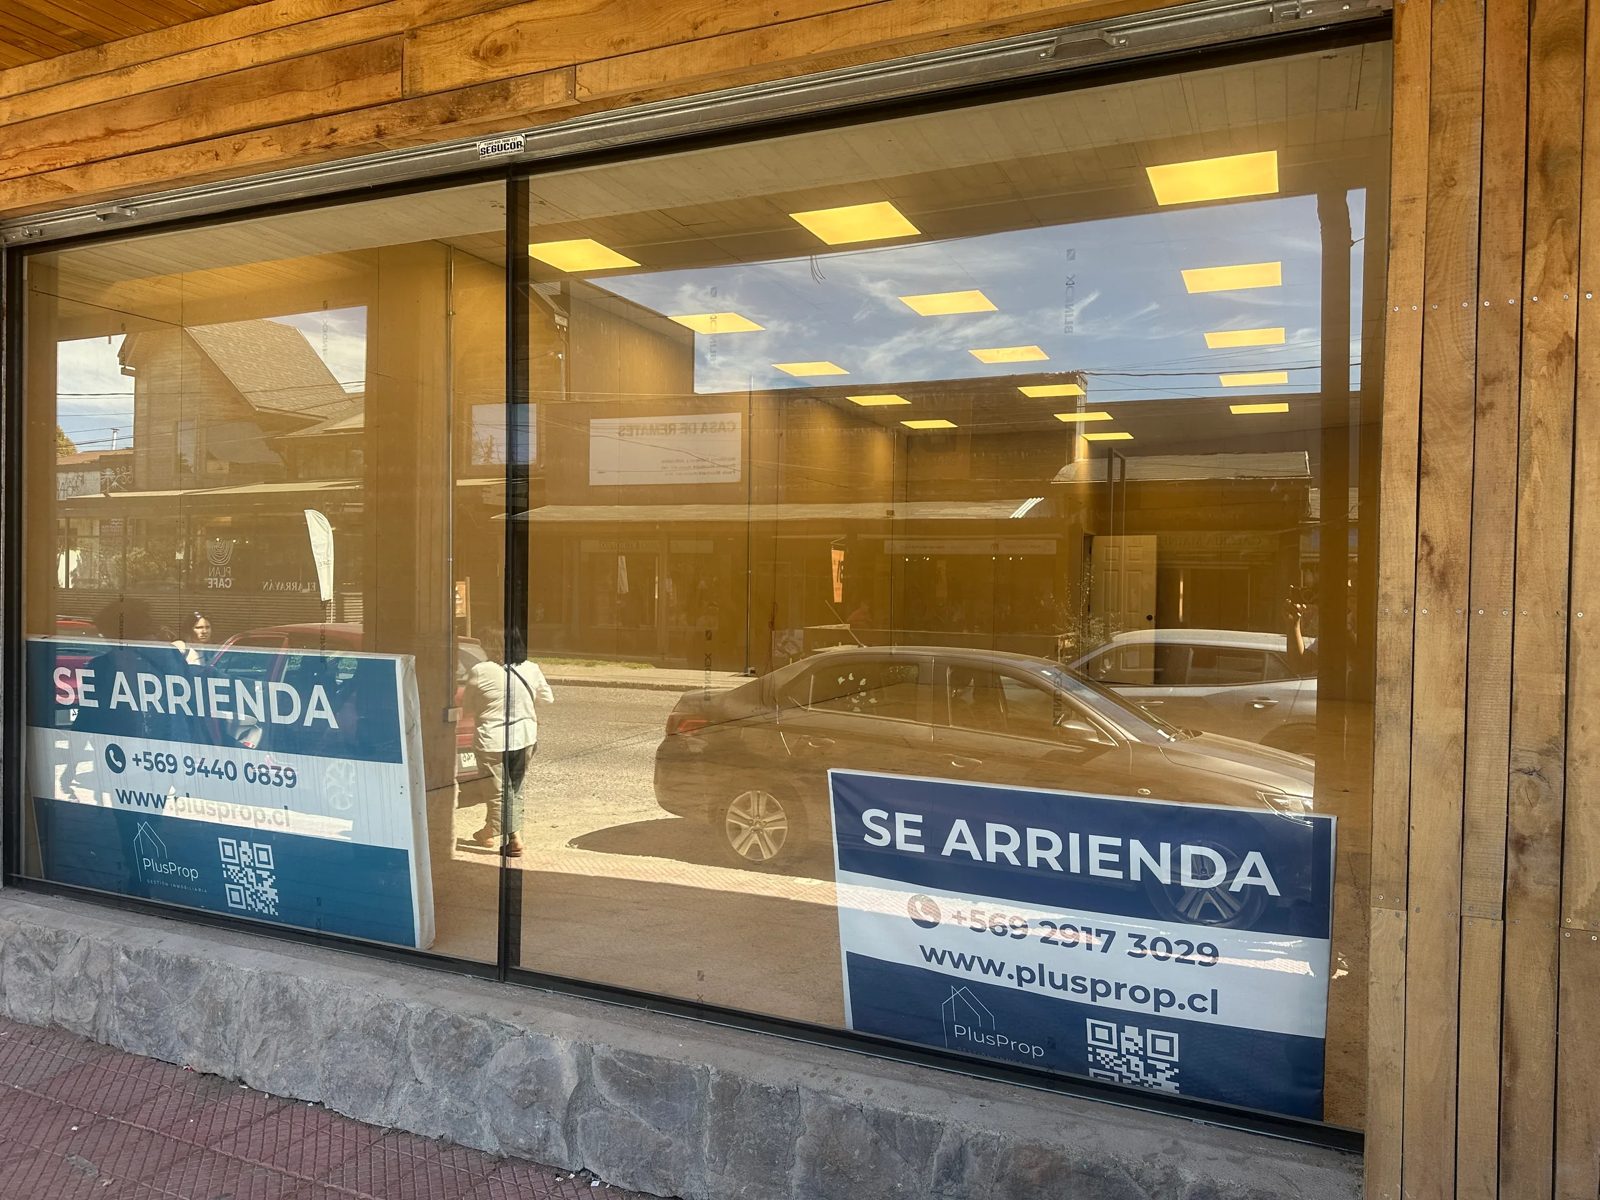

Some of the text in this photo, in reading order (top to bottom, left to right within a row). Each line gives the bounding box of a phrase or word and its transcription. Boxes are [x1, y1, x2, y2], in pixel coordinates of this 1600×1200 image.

[480, 141, 524, 156] SEGUCOR
[52, 666, 339, 729] SE ARRIENDA
[132, 751, 297, 789] +569 9440 0839
[116, 788, 291, 828] www.plusprop.cl
[142, 857, 199, 881] PlusProp
[861, 808, 1281, 897] SE ARRIENDA
[951, 908, 1219, 967] +569 2917 3029
[919, 944, 1219, 1015] www.plusprop.cl
[953, 1023, 1045, 1059] PlusProp
